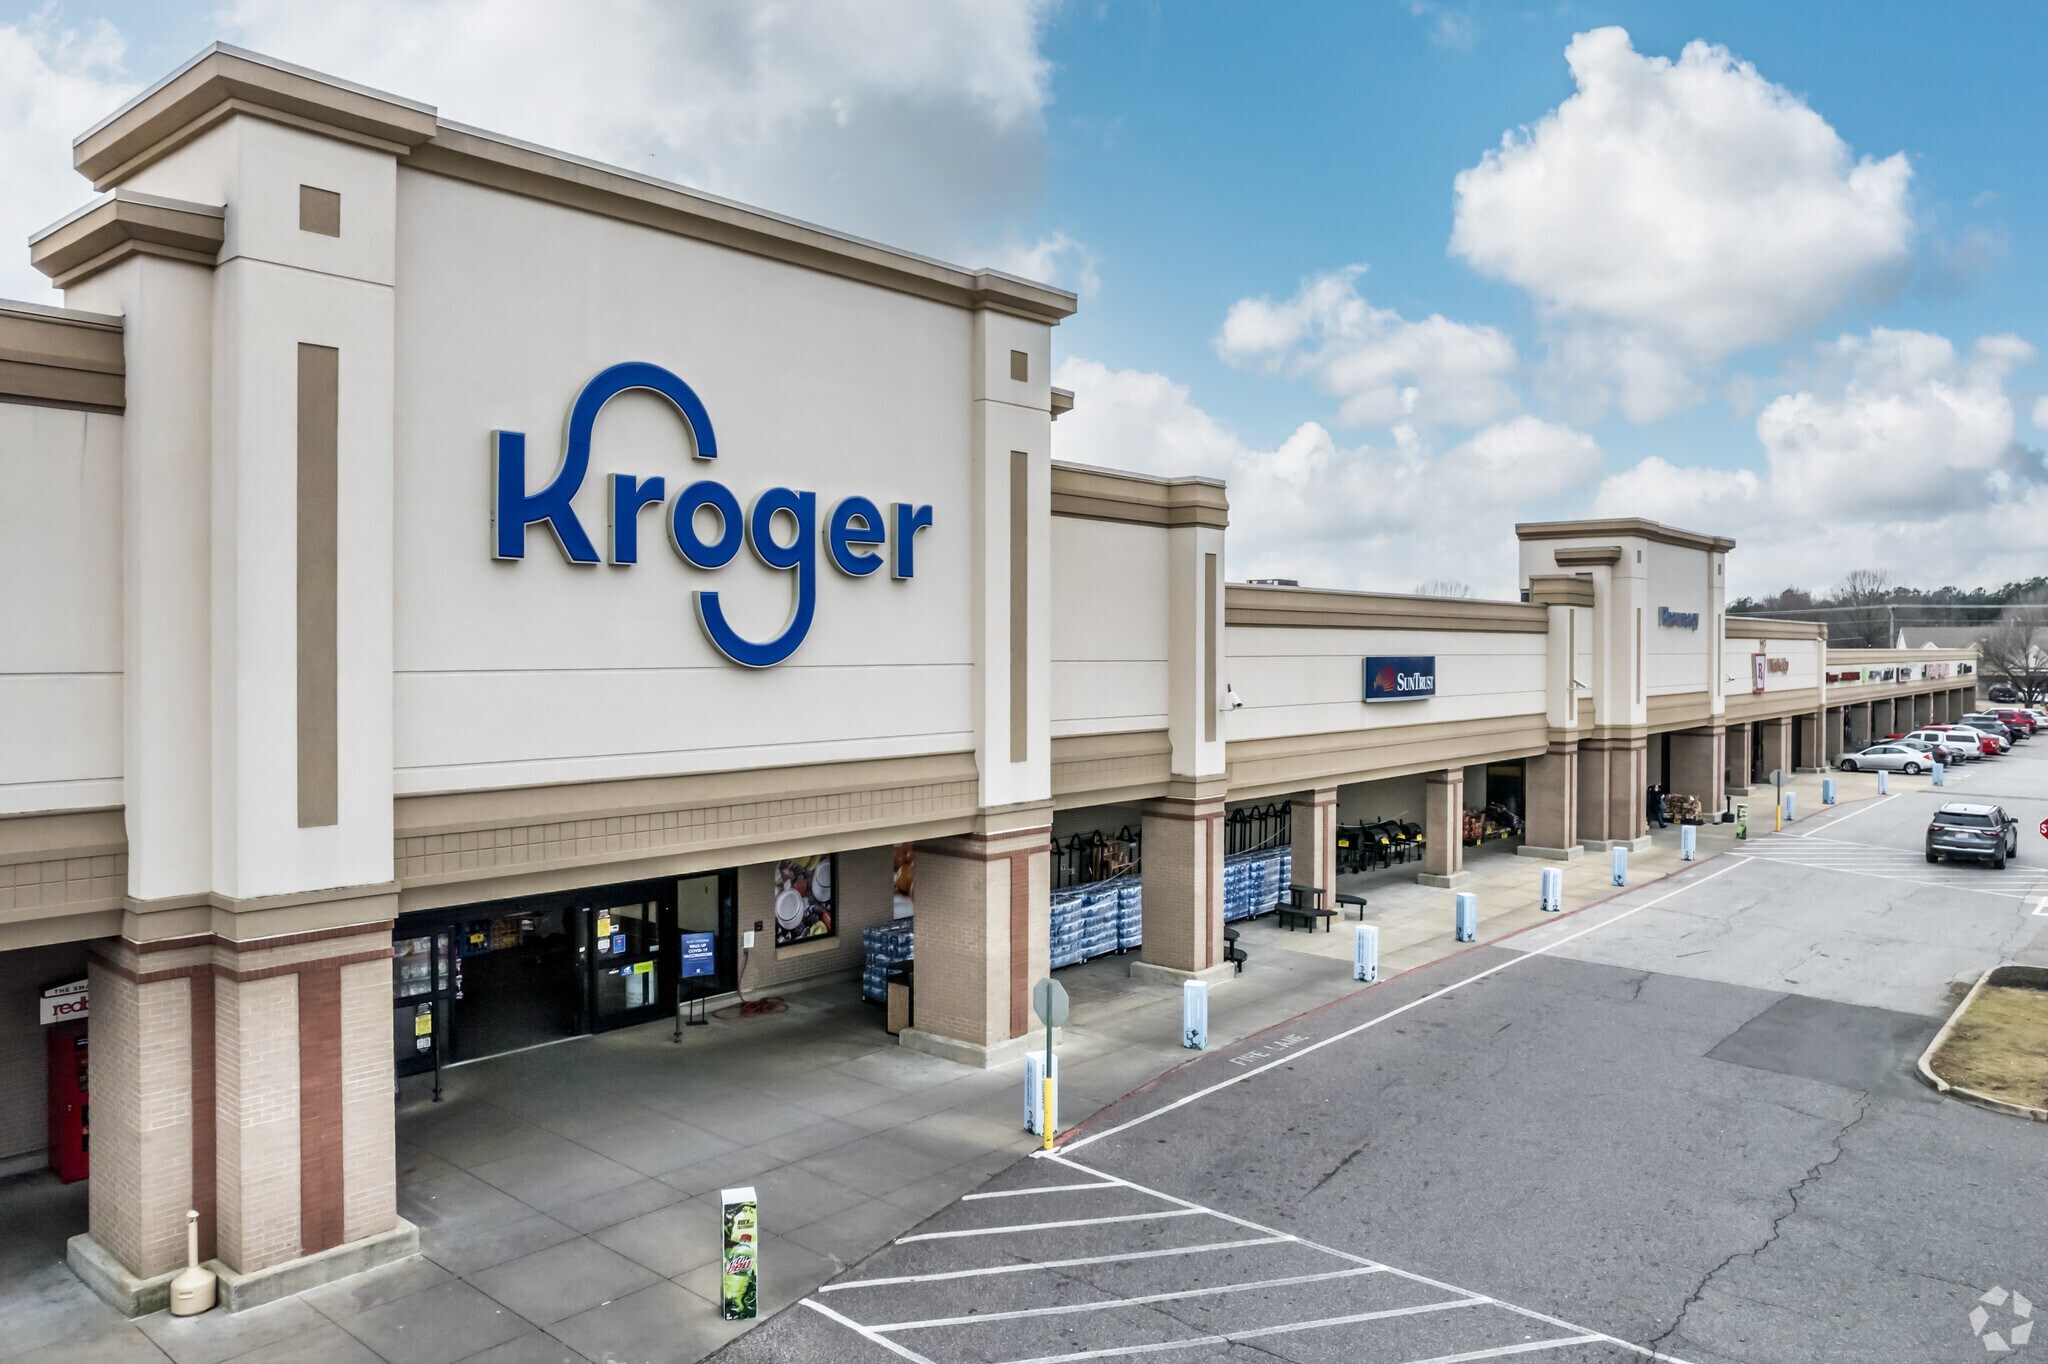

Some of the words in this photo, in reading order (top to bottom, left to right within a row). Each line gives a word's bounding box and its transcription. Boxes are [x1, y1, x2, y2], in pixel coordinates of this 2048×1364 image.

[491, 361, 932, 668] Kroger
[1228, 1250, 1270, 1266] FIRE
[1263, 1034, 1310, 1051] LANE
